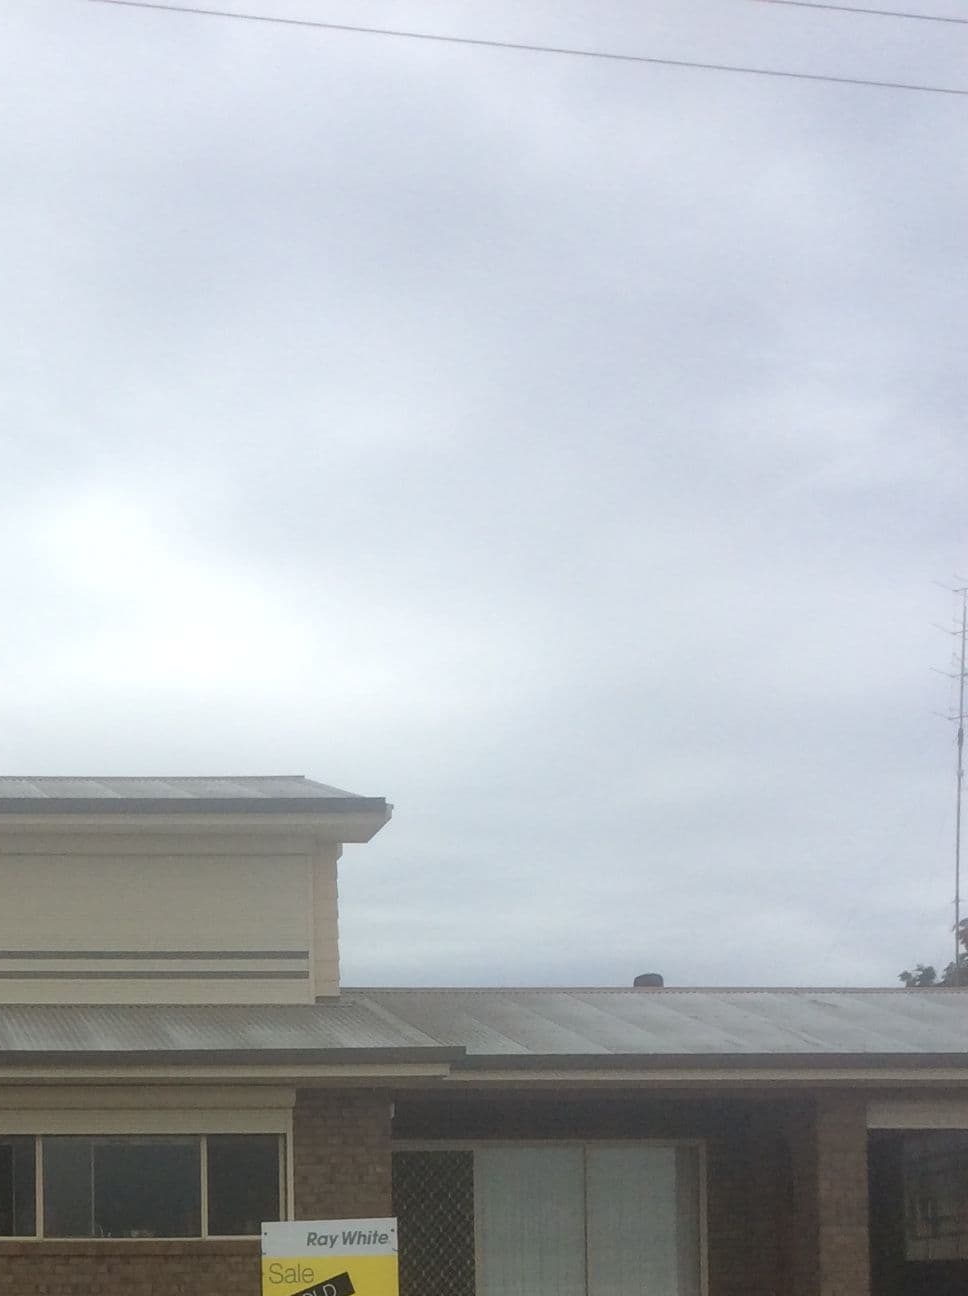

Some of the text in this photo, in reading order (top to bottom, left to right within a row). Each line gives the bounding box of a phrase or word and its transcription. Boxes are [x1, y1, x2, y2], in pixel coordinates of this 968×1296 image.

[306, 1229, 389, 1249] Ray White
[268, 1262, 315, 1285] Sale
